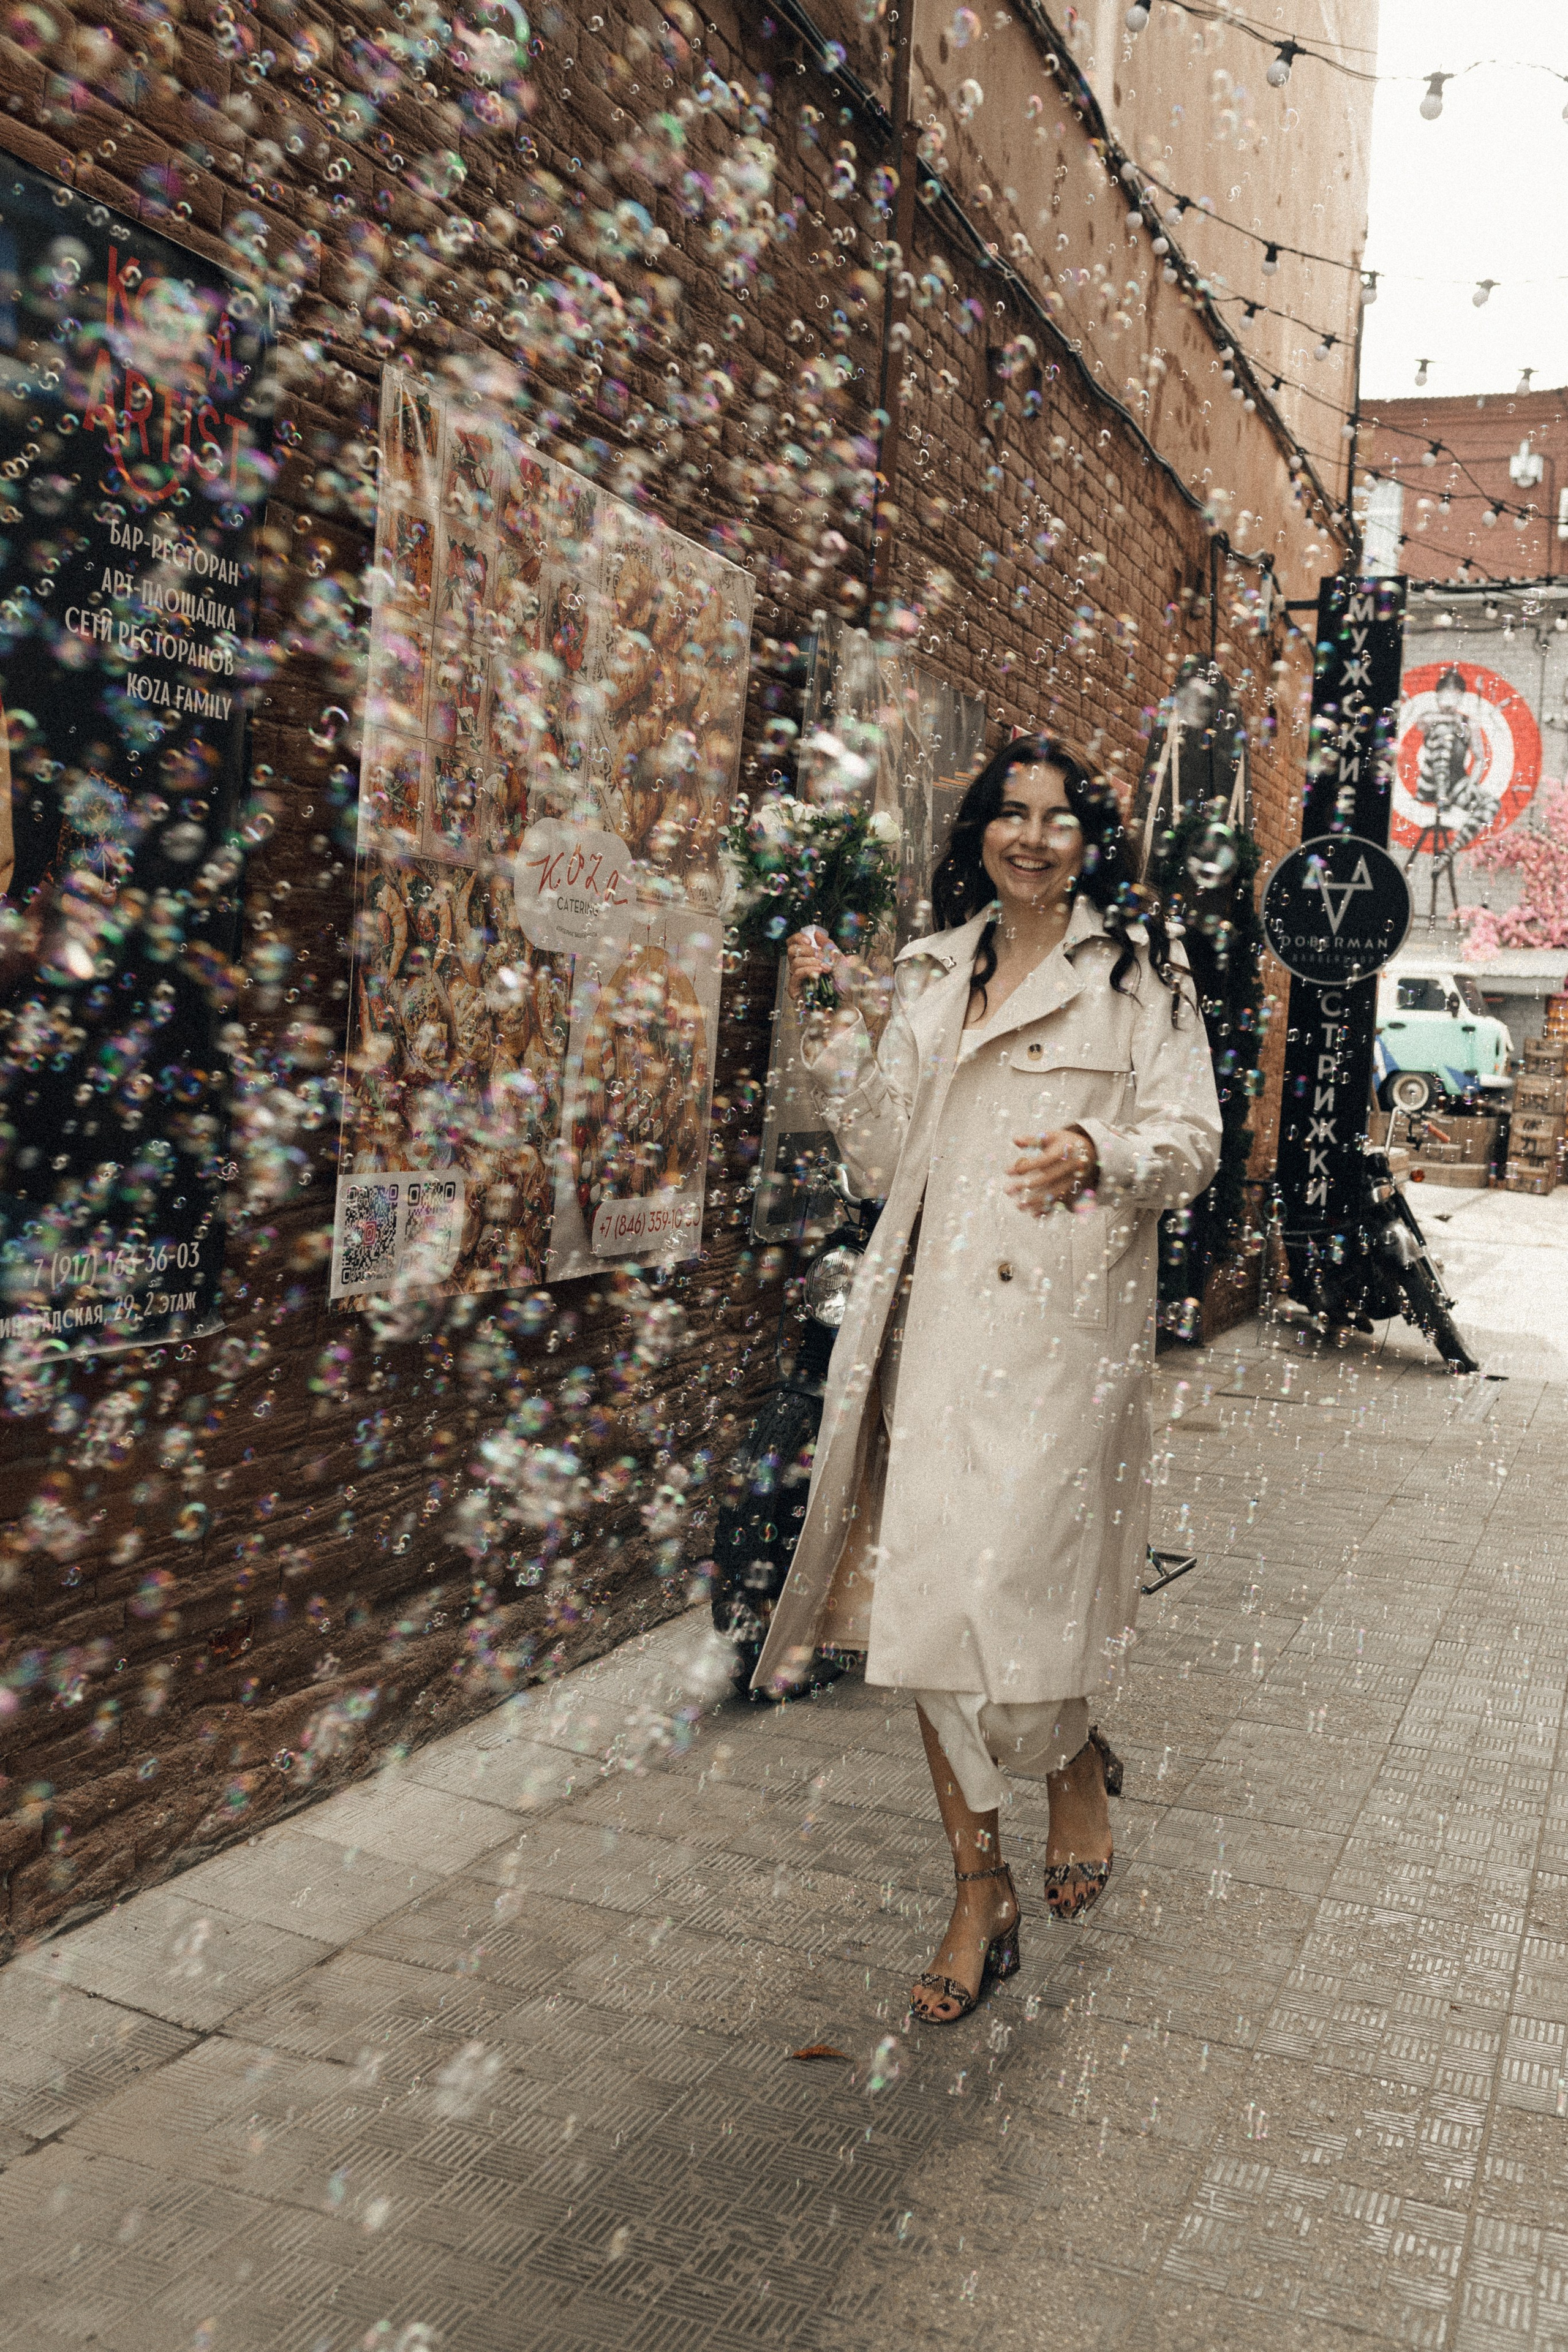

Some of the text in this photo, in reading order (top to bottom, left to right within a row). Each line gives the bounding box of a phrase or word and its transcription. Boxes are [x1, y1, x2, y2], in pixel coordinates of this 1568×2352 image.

[83, 349, 249, 502] ARTIST
[110, 519, 239, 586] БАР-РЕСТОРАН
[101, 567, 236, 631] АРТ-ПЛОЩАДКА
[65, 606, 234, 676] СЕТИ РЕСТОРАНОВ
[127, 672, 232, 721] KOZA FAMILY
[1338, 595, 1374, 815] МУЖСКИЕ
[557, 896, 599, 917] CATERING
[1281, 936, 1388, 949] DOBERMAN
[1306, 991, 1343, 1206] СТРИЖКИ
[600, 1216, 612, 1238] +7
[614, 1212, 646, 1240] (846)
[51, 1253, 98, 1291] (917)
[144, 1291, 154, 1316] 2
[158, 1291, 197, 1314] ЭТАЖ
